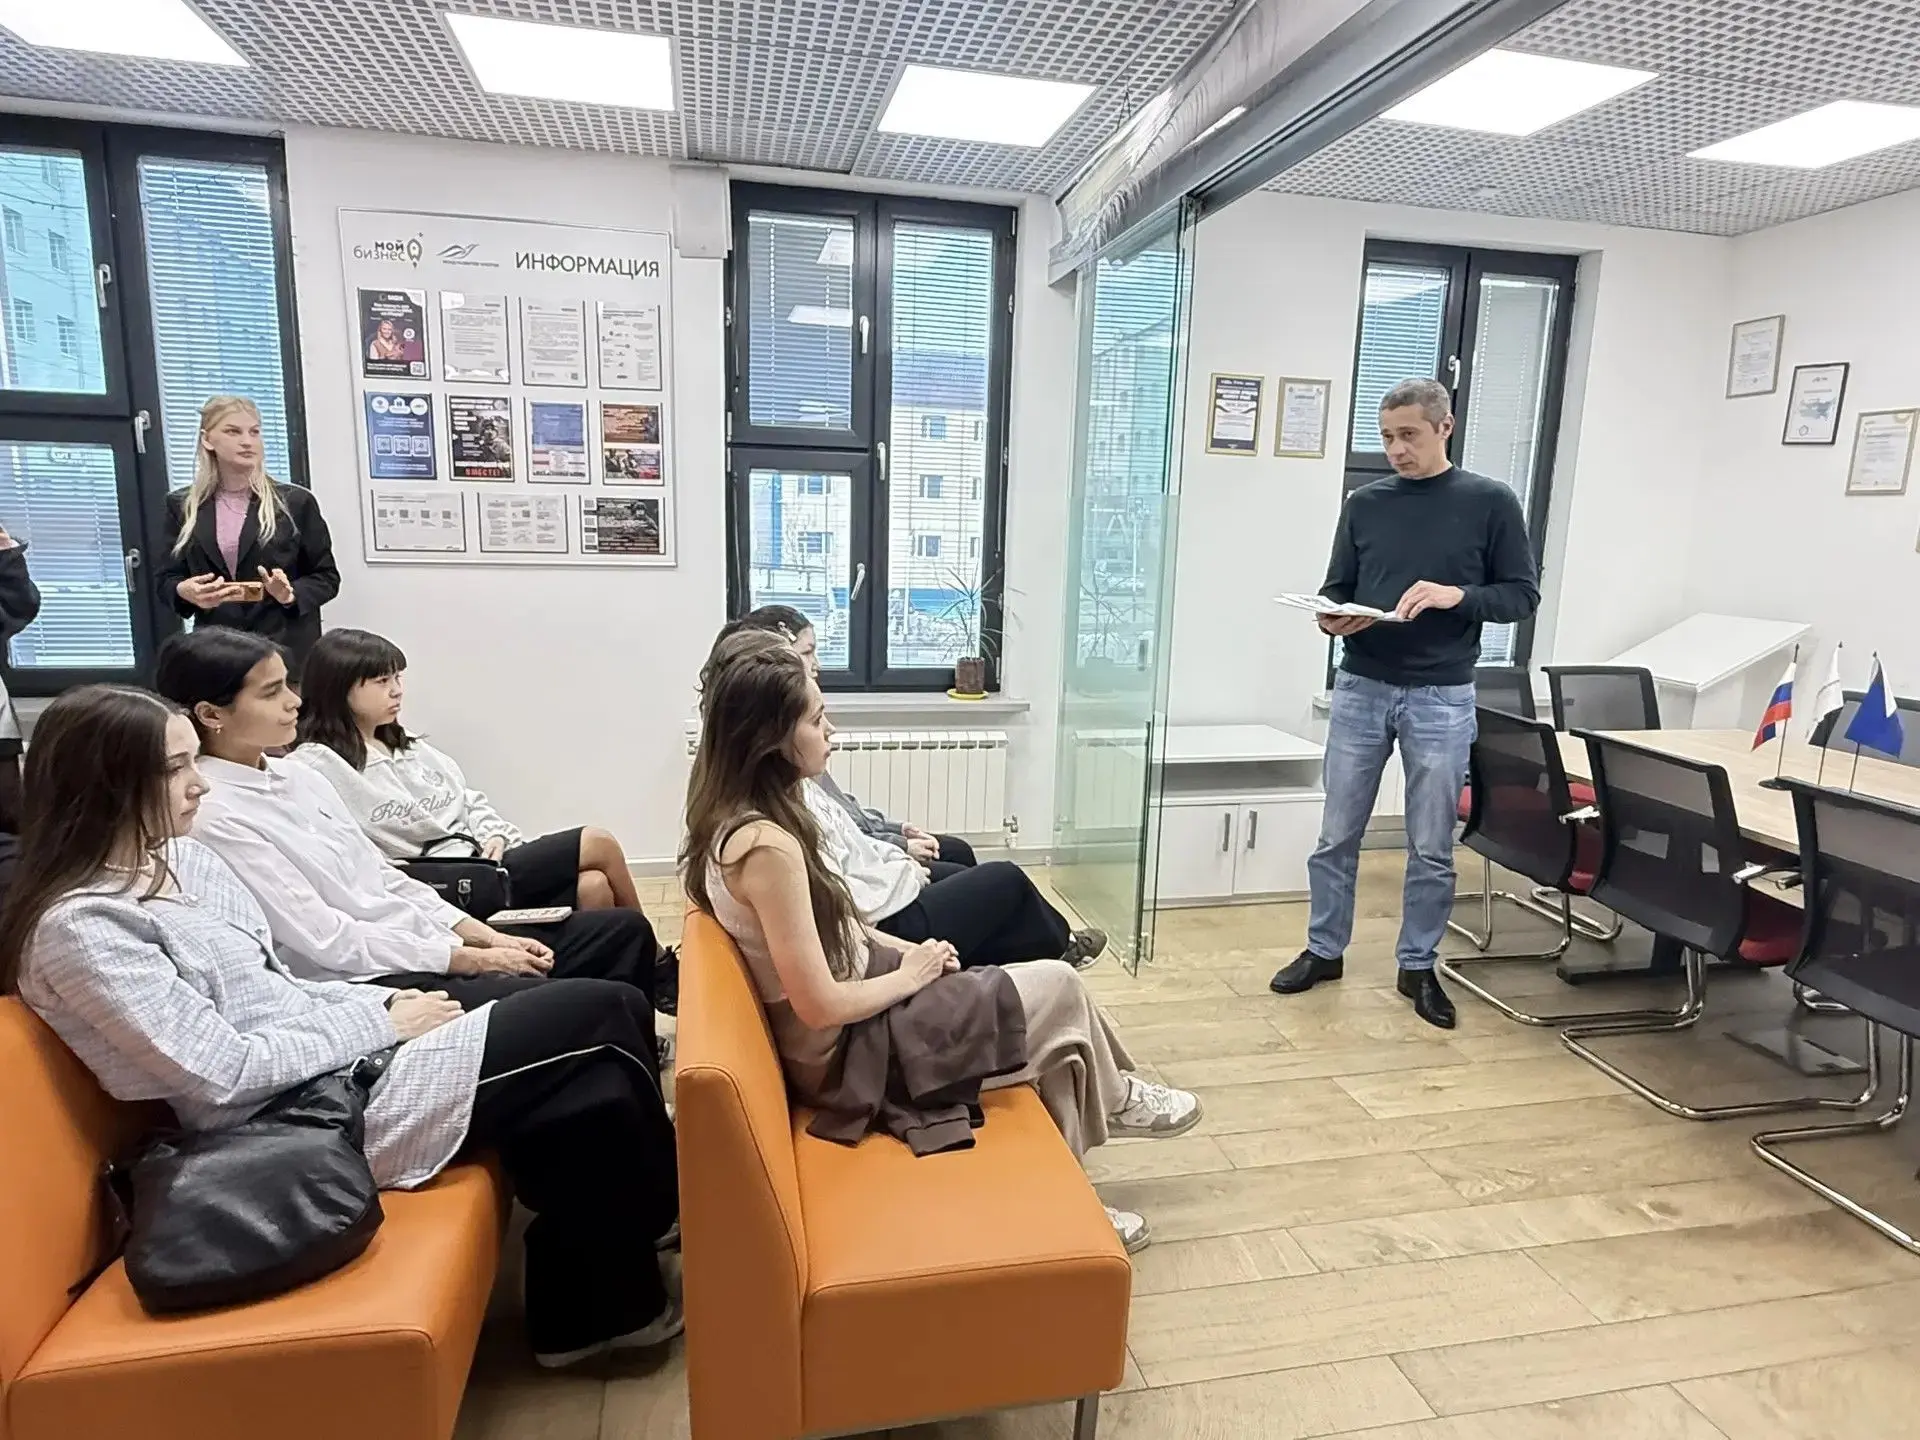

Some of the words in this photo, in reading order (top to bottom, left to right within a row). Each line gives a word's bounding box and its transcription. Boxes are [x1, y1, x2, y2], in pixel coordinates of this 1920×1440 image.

[353, 245, 406, 261] бизнес
[374, 239, 405, 251] мой
[515, 251, 660, 280] ИНФОРМАЦИЯ
